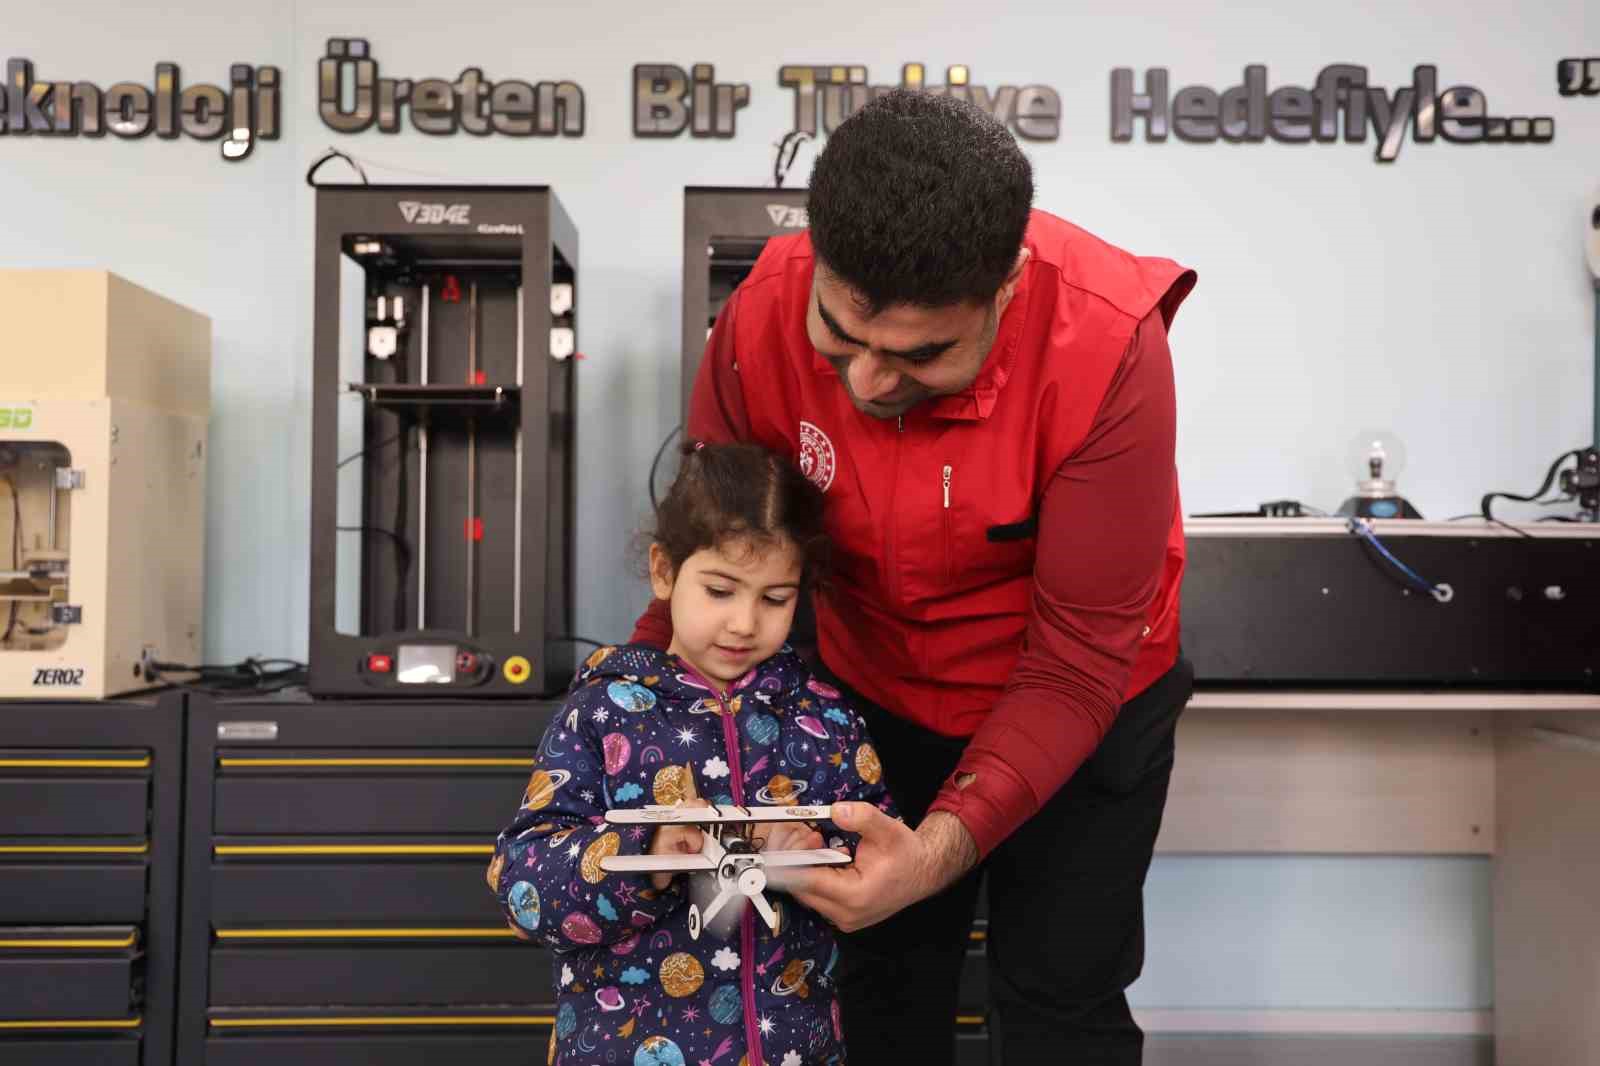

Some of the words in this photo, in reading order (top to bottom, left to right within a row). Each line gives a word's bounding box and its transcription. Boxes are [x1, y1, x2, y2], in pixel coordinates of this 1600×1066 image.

[0, 57, 281, 161] knoloji
[317, 37, 586, 136] Üreten
[633, 63, 749, 138] Bir
[33, 668, 84, 685] ZERO2
